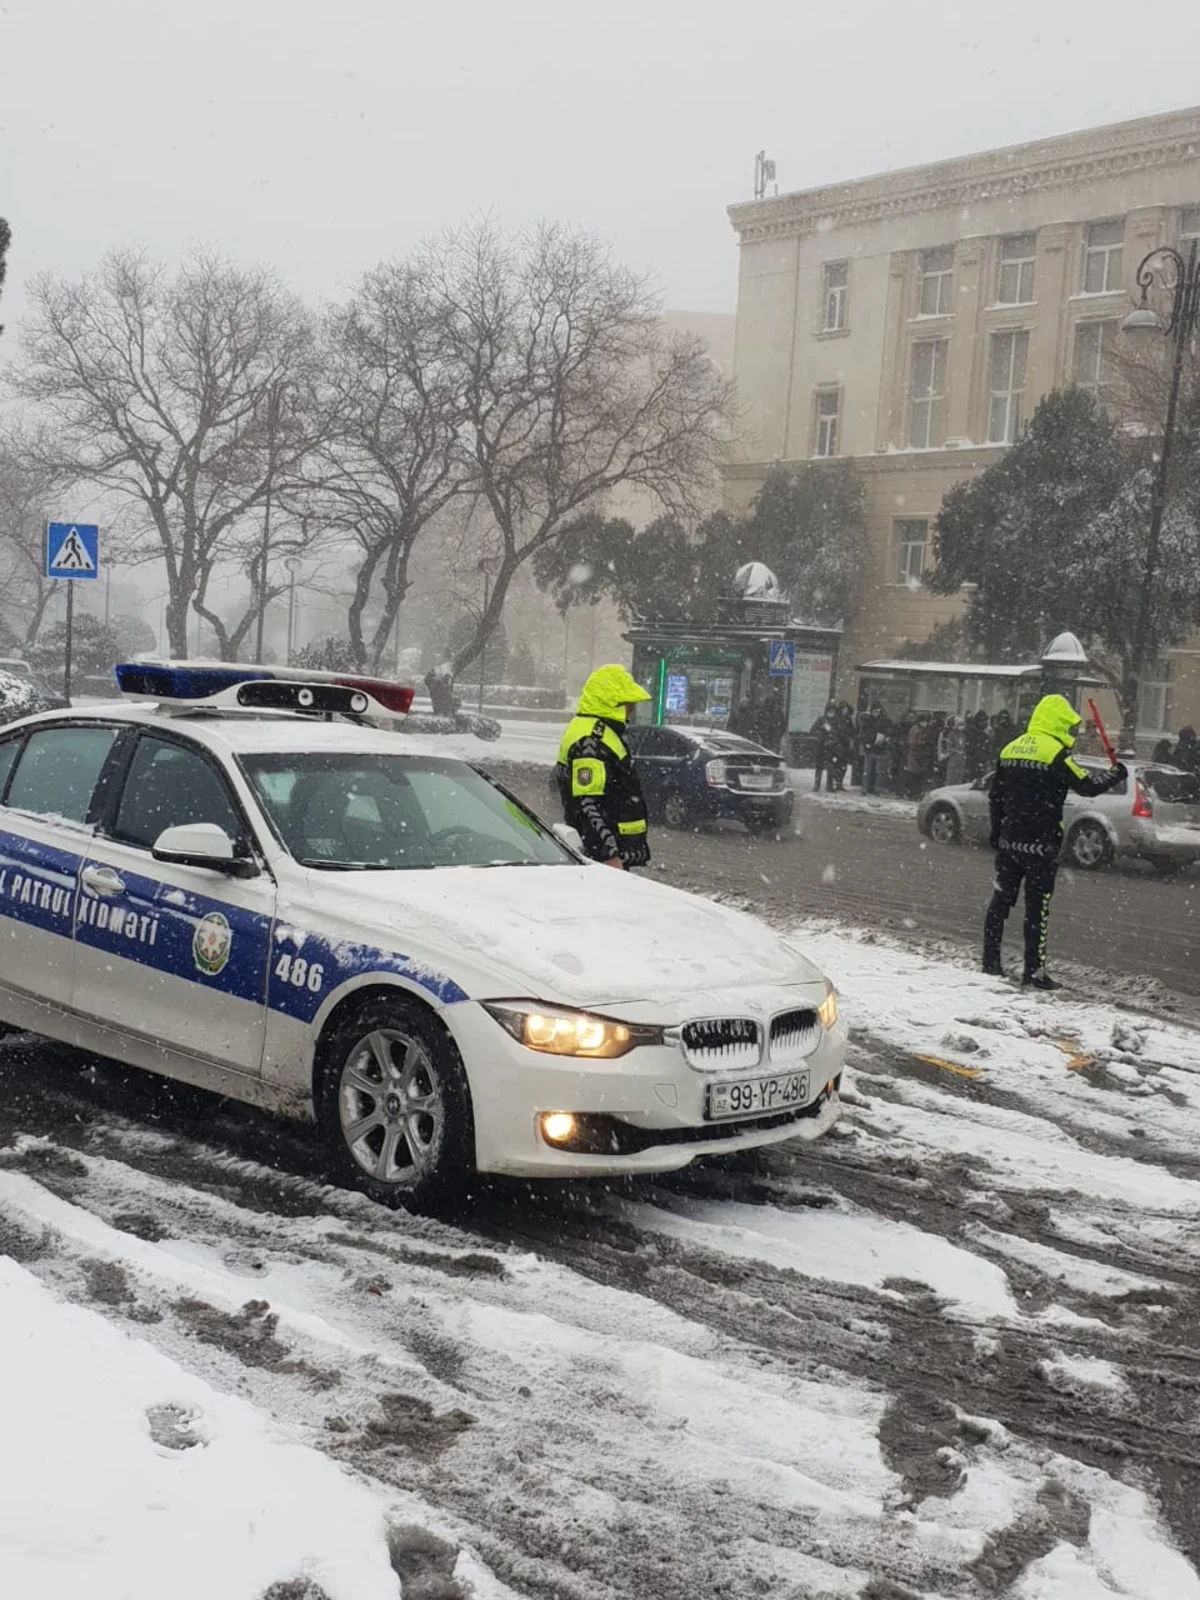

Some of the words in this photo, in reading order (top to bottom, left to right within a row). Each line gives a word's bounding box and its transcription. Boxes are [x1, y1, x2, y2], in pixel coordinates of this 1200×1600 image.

[11, 875, 71, 917] PATRUL
[275, 953, 324, 992] 486
[731, 1075, 807, 1110] 99-YP-486
